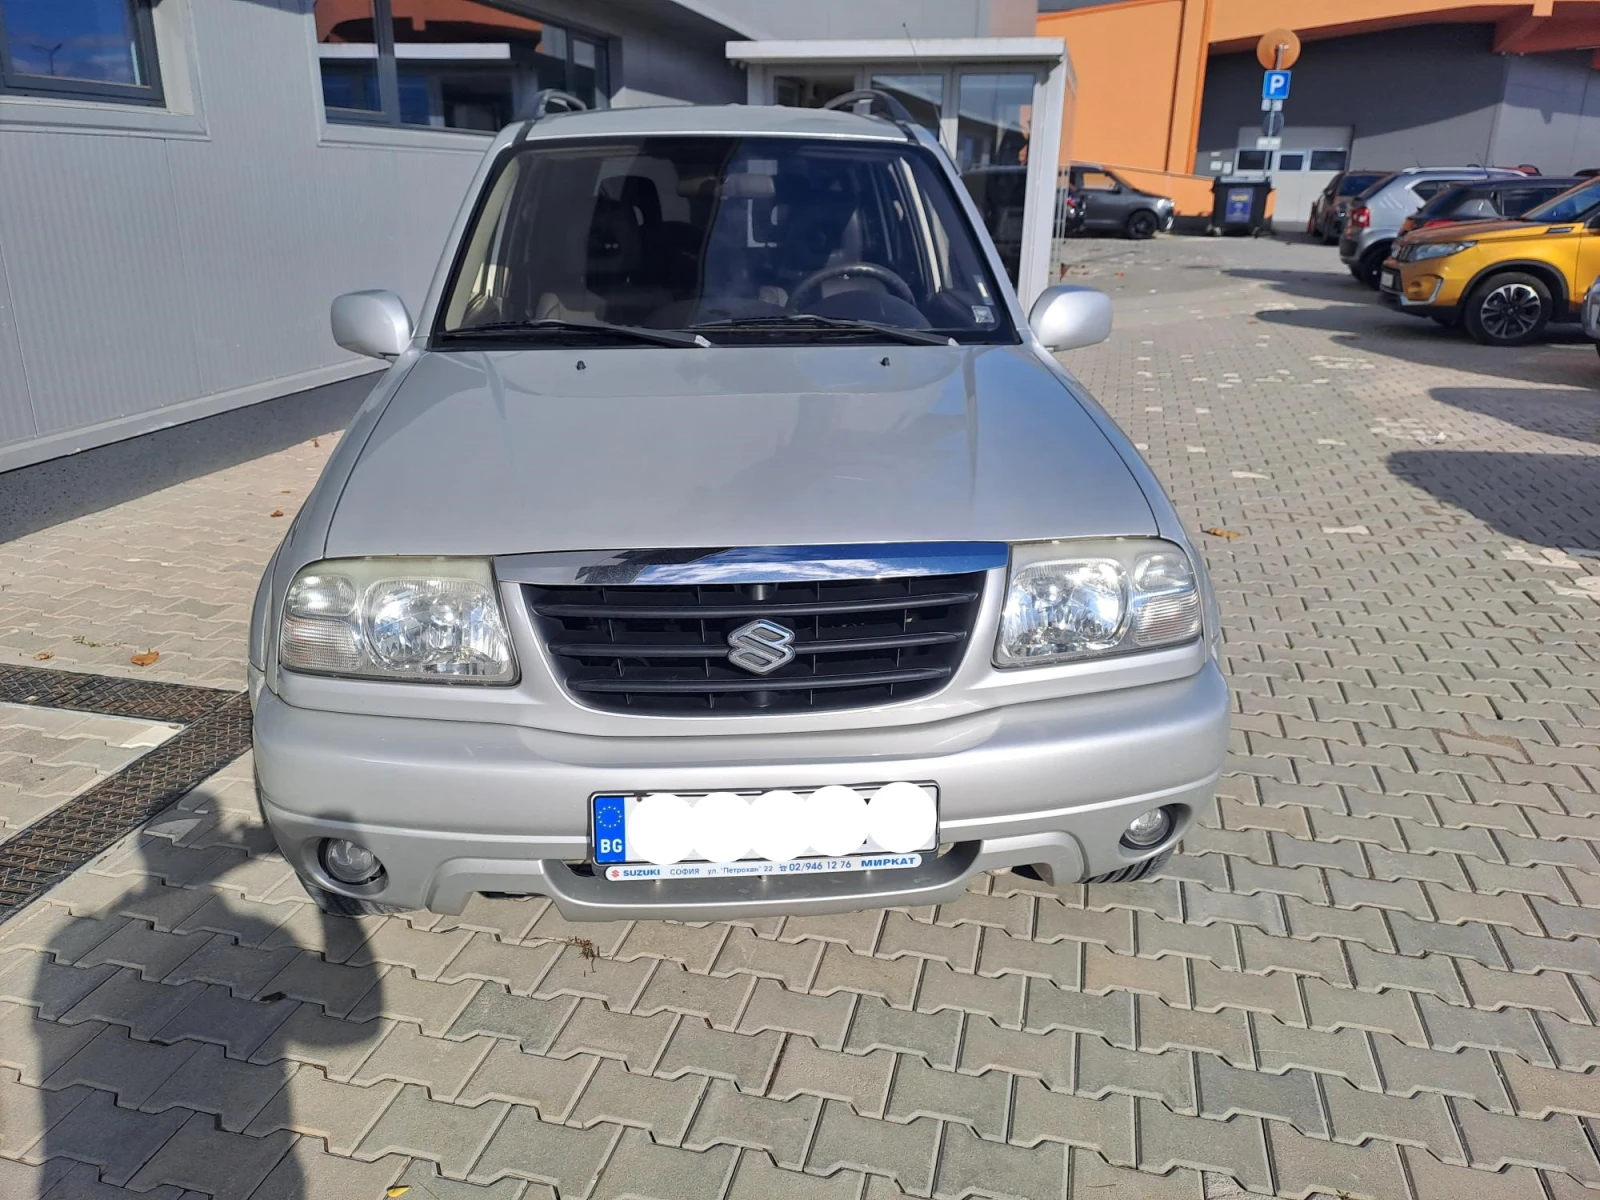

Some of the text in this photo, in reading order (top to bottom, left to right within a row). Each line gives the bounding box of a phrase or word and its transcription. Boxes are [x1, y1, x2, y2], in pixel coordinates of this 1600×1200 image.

[1269, 74, 1285, 95] P
[600, 838, 623, 854] BG
[623, 869, 661, 877] SUZUKI
[670, 867, 700, 876] СОФИЯ
[789, 863, 823, 872] 02/946
[827, 861, 837, 870] 12
[840, 860, 852, 869] 76
[861, 857, 916, 867] МИРКАТ
